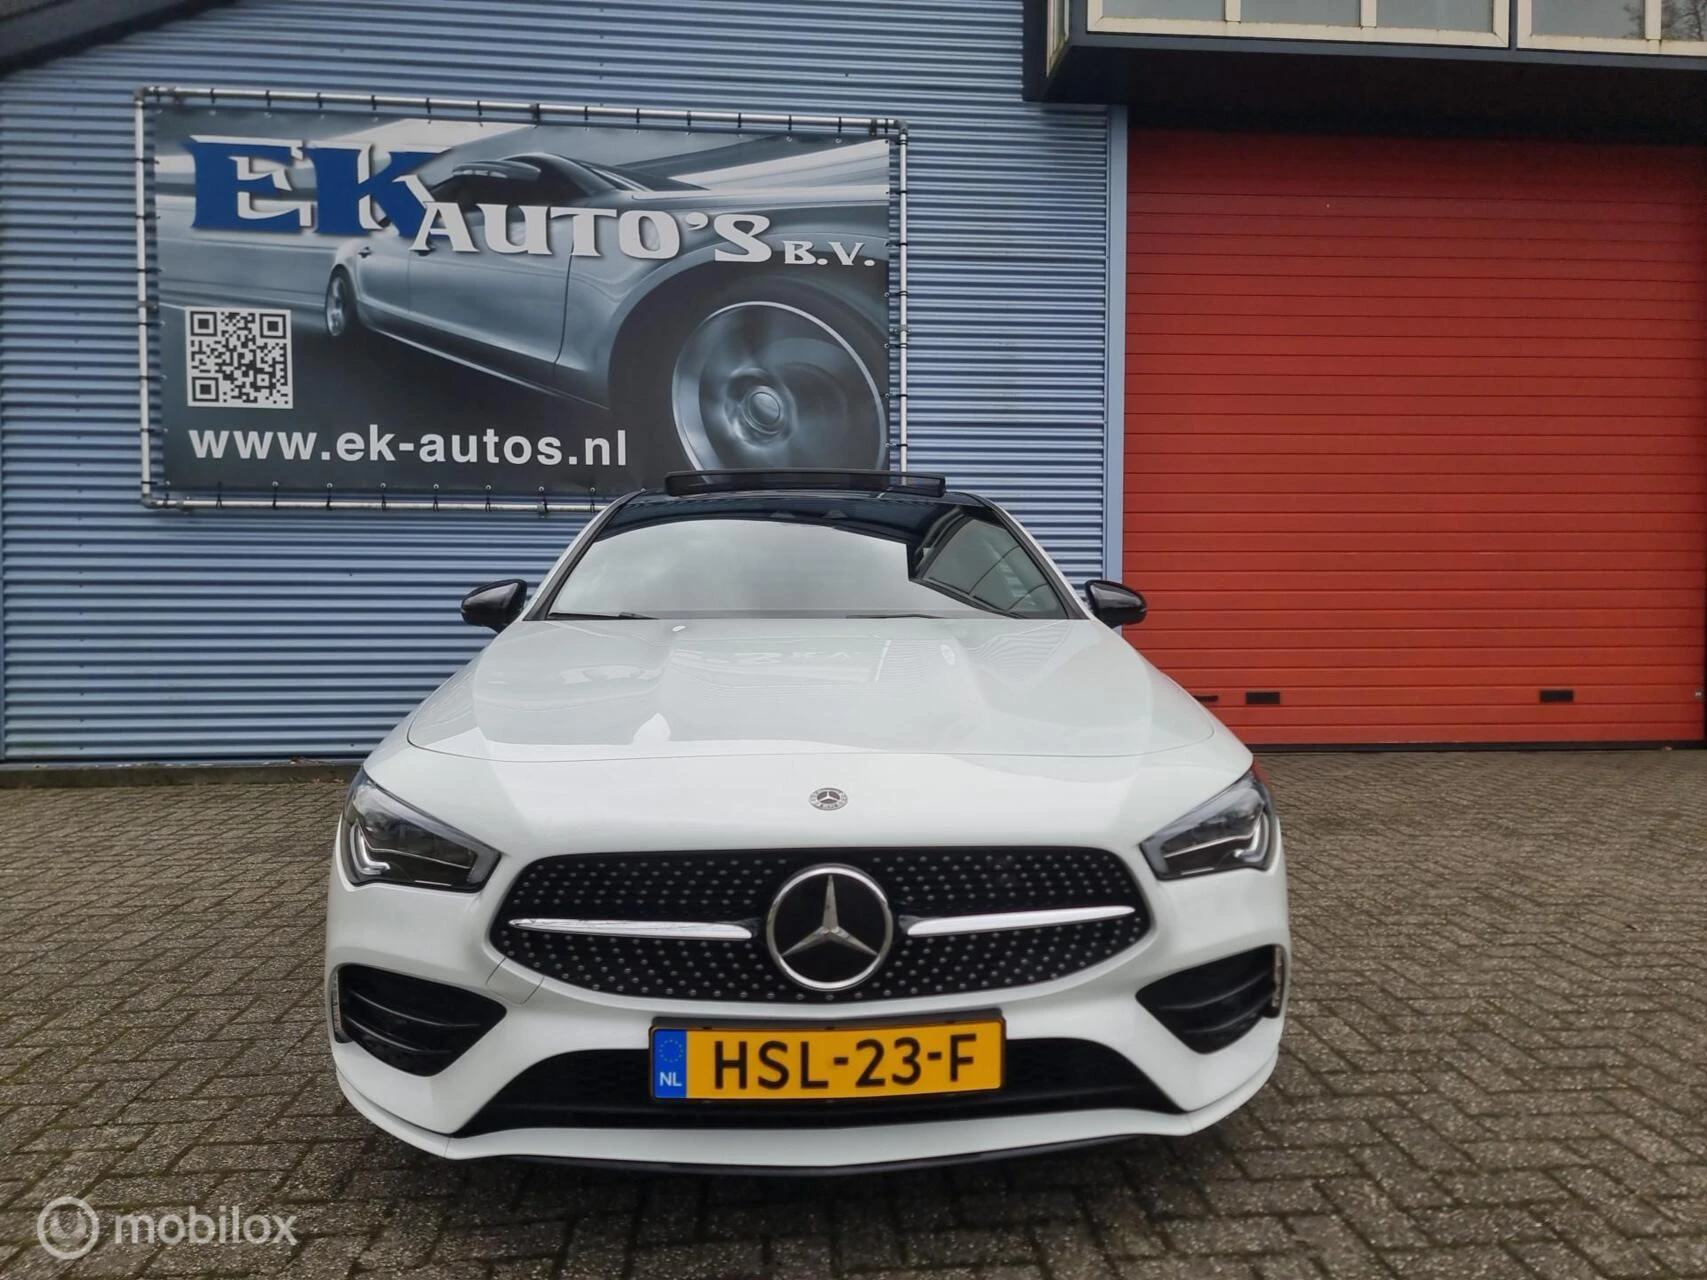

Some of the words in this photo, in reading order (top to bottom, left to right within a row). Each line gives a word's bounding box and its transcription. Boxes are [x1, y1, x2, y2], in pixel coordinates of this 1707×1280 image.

[783, 240, 876, 268] B.V.
[189, 424, 627, 467] www.ek-autos.nl
[659, 1071, 682, 1087] NL
[714, 1033, 977, 1090] HSL-23-F
